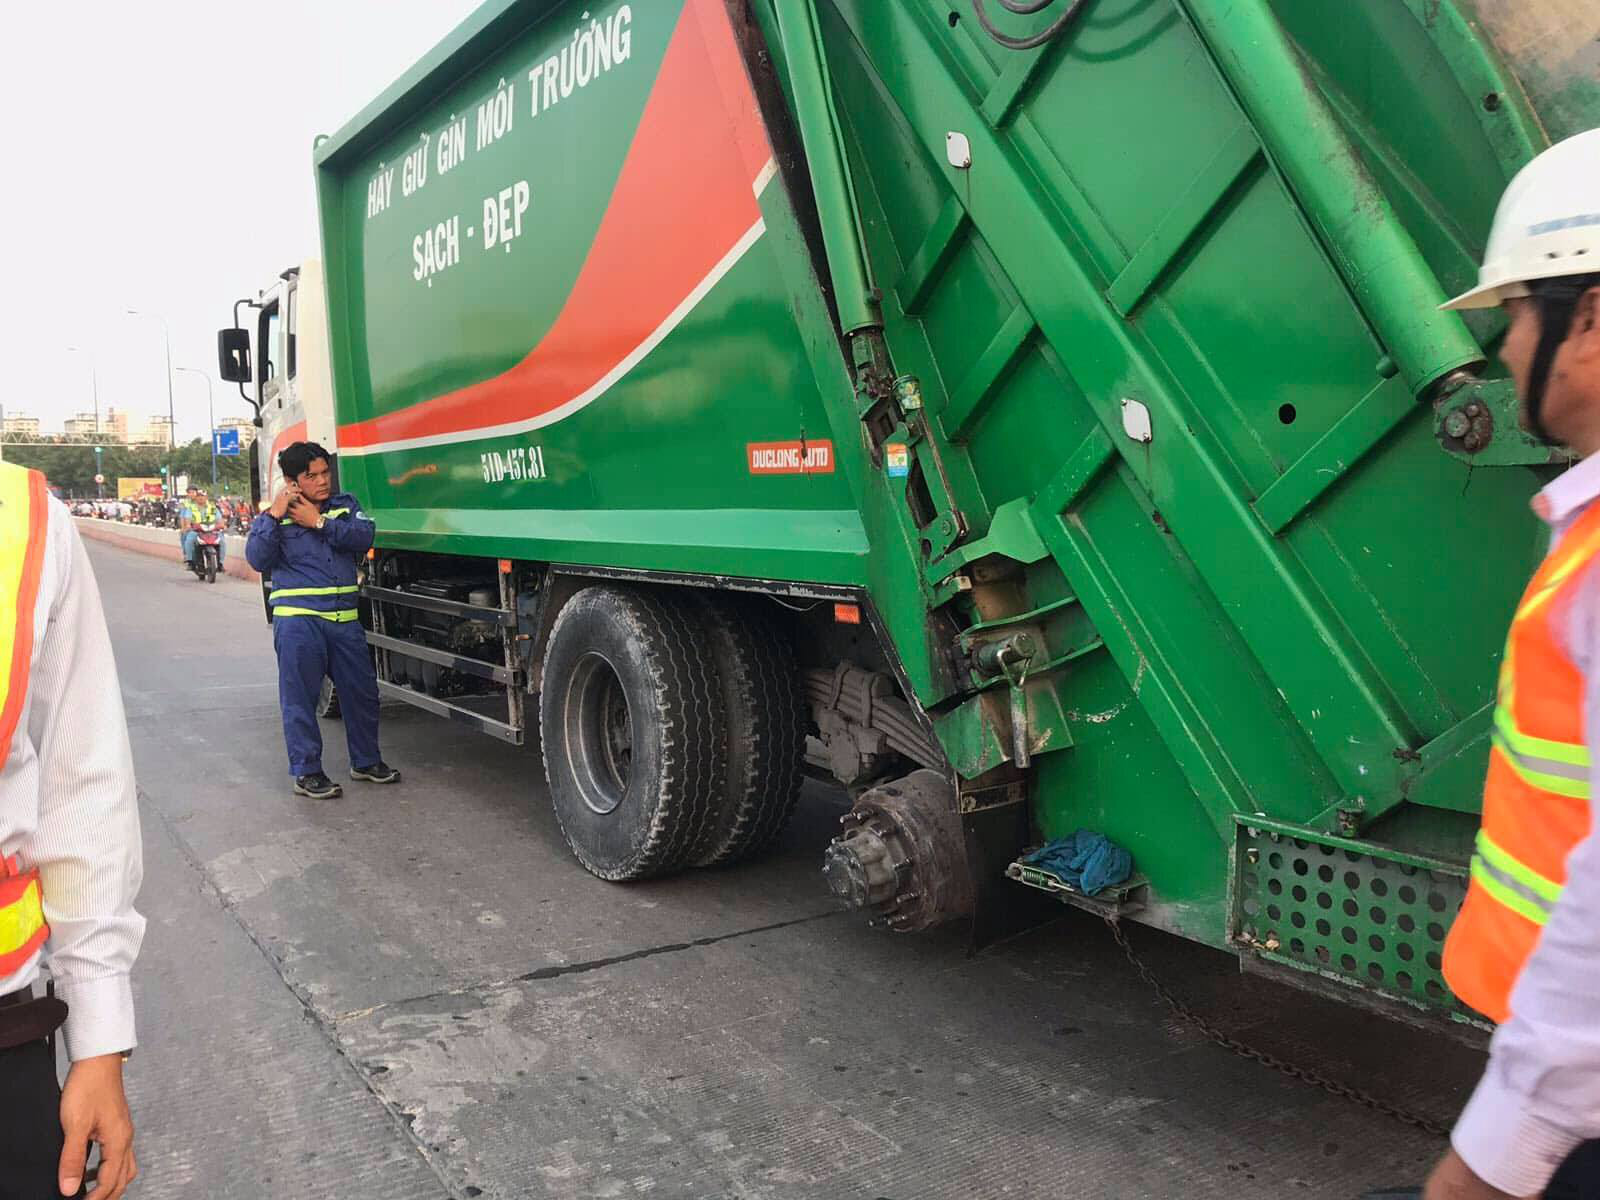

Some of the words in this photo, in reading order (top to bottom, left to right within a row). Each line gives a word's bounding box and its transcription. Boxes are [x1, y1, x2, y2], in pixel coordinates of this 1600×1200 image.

[476, 77, 514, 152] MÔI
[528, 5, 632, 118] TRƯỜNG
[412, 215, 460, 288] SẠCH
[483, 180, 530, 253] ĐẸP
